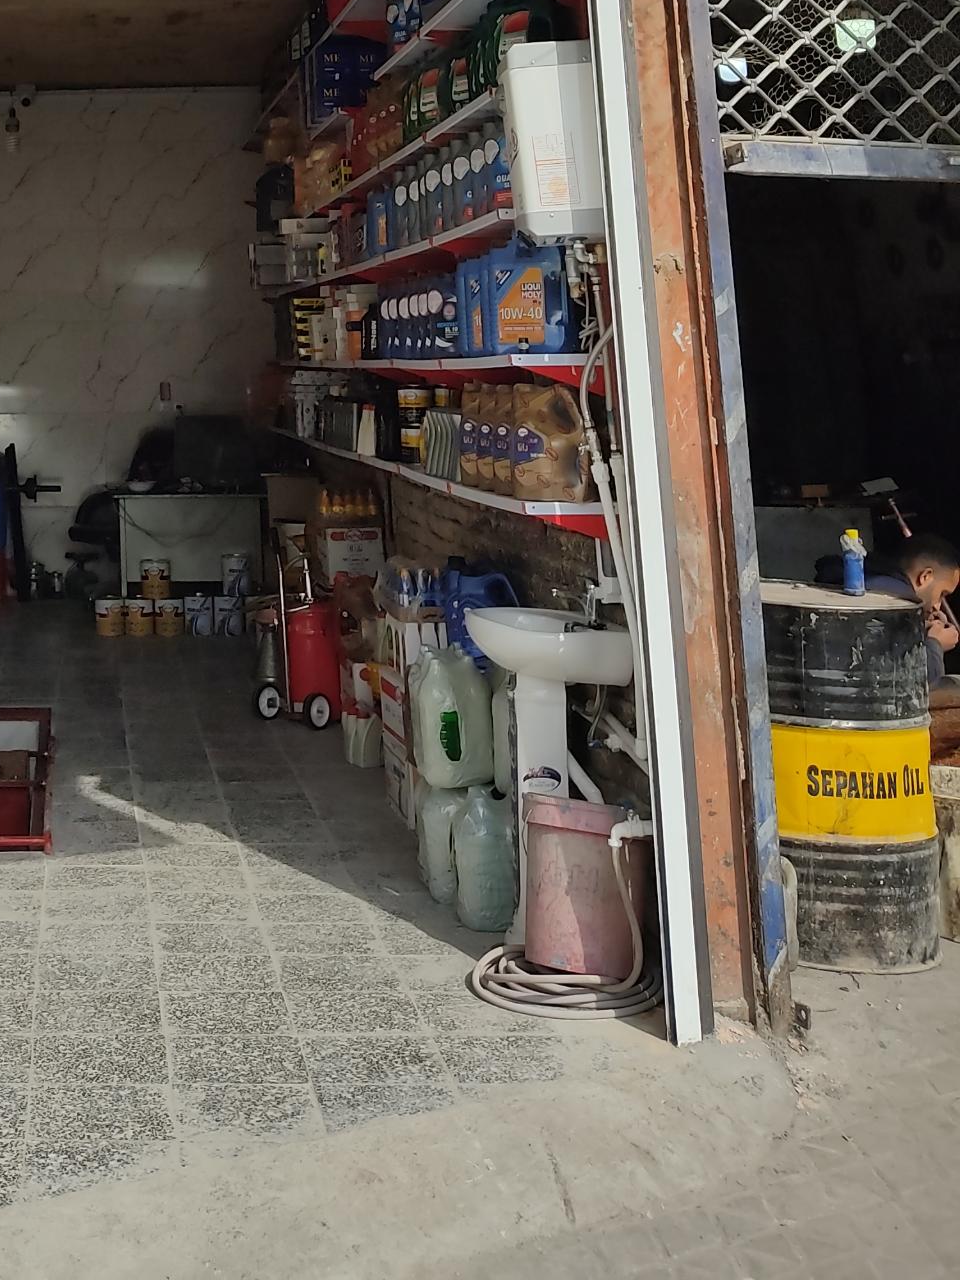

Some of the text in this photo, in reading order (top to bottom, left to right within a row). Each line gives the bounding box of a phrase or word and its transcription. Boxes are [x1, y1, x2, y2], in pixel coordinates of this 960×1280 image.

[522, 283, 541, 291] LIQUI
[521, 291, 542, 299] MOLY
[500, 307, 543, 320] 10W-40
[807, 764, 924, 799] SEPAHAN OIL
